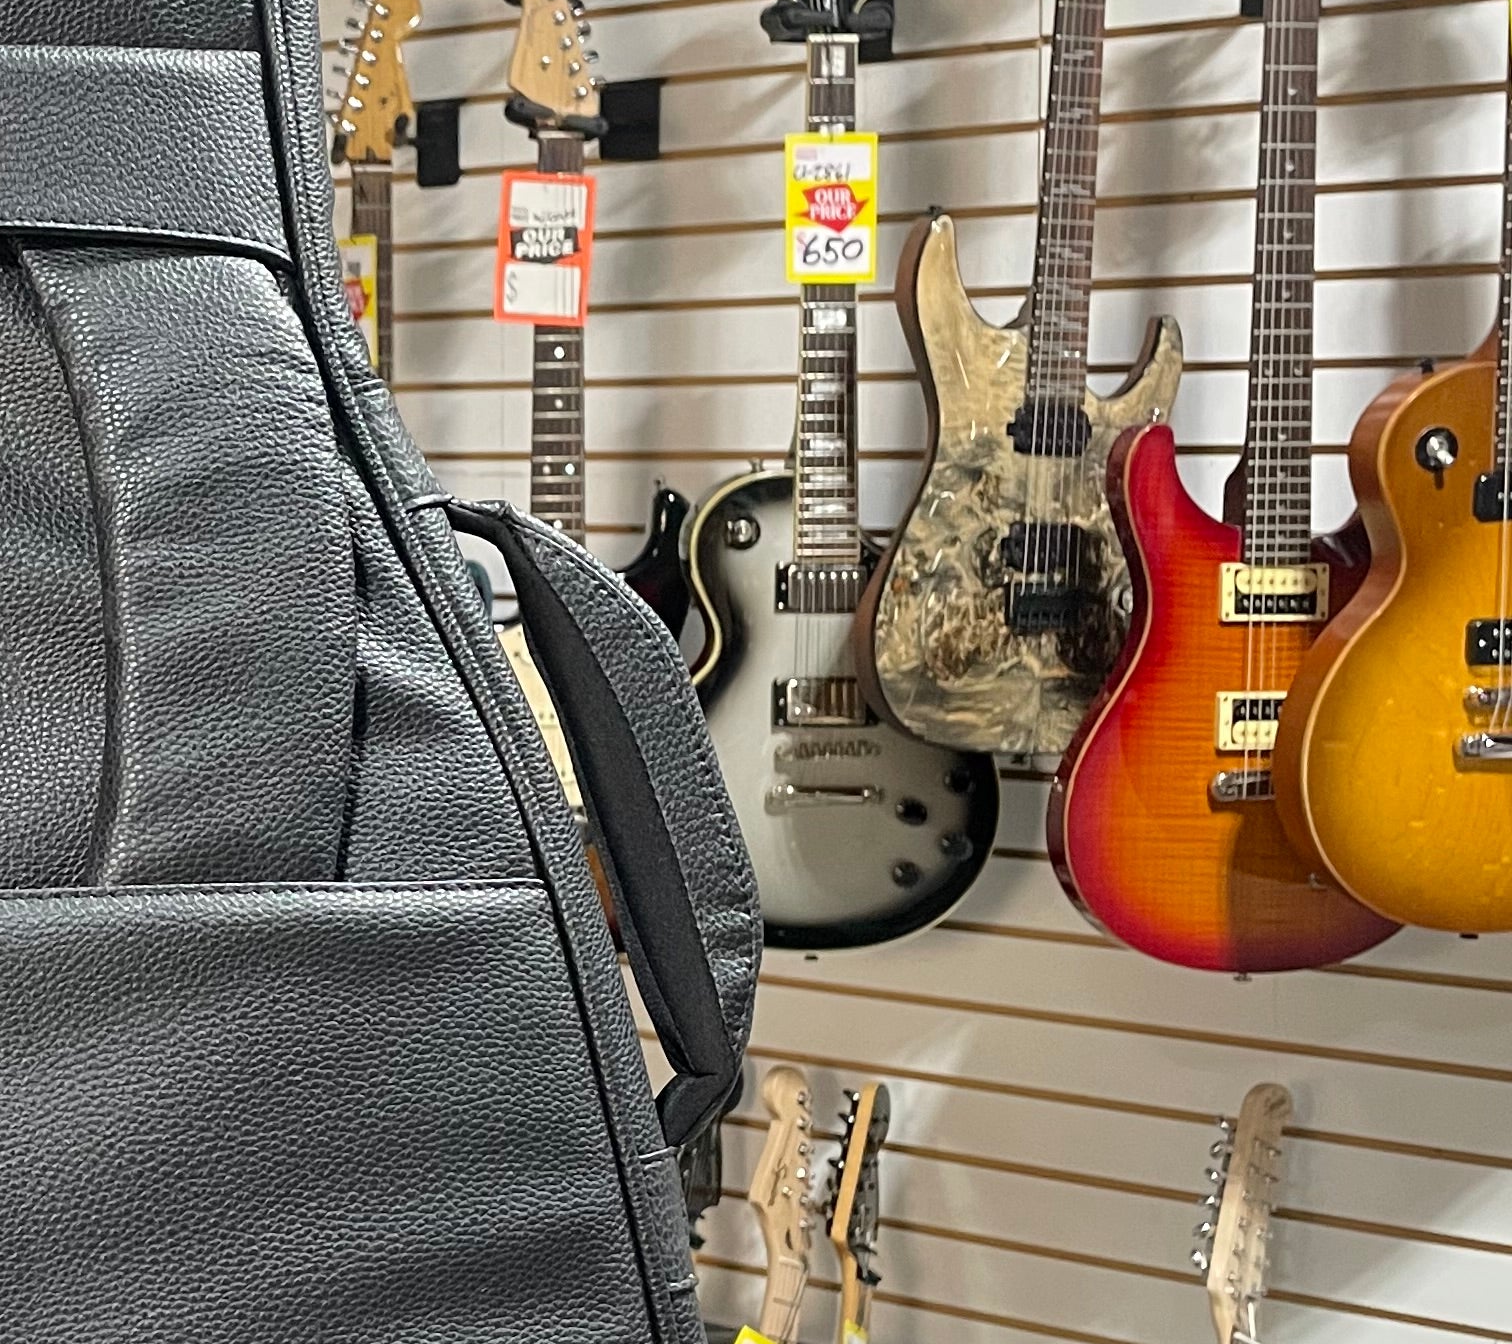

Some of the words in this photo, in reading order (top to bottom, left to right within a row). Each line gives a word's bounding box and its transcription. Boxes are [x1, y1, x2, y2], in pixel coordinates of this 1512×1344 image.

[814, 188, 851, 204] OUR
[808, 203, 856, 221] PRICE
[522, 228, 566, 244] OUR
[515, 239, 574, 260] PRICE
